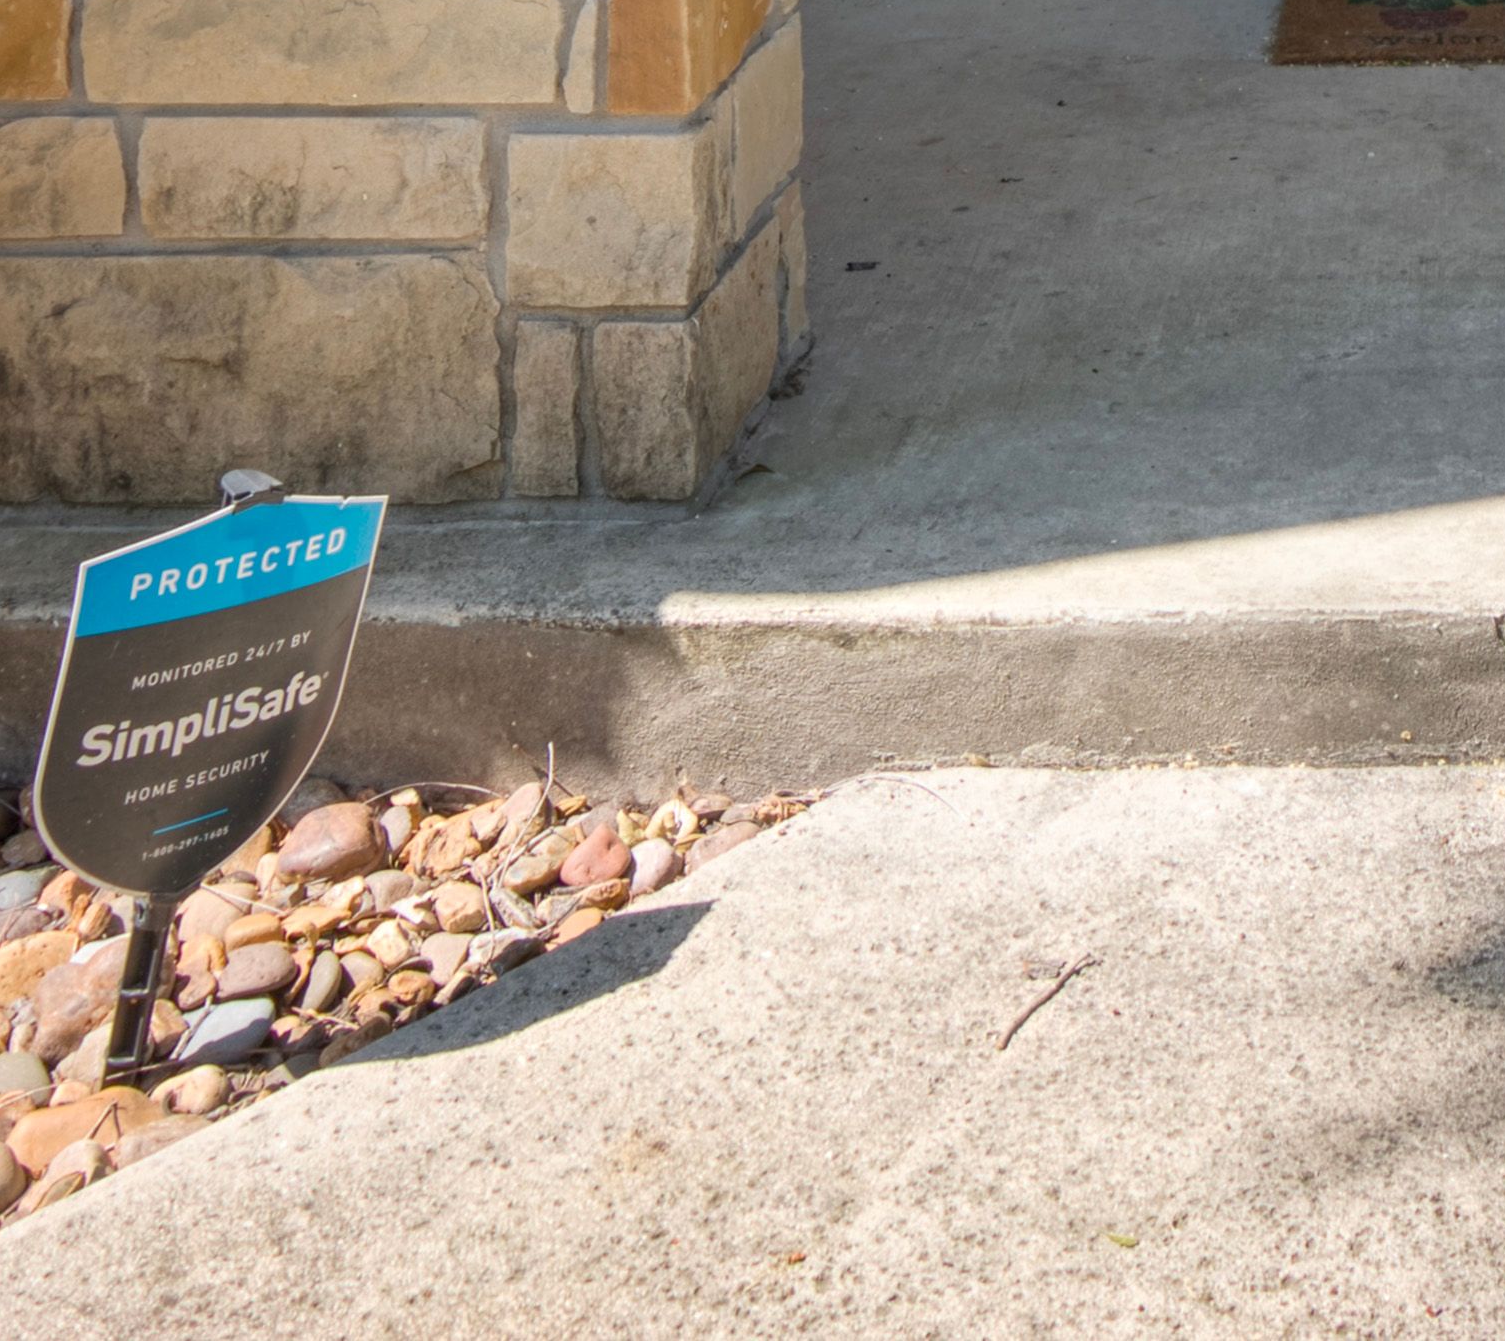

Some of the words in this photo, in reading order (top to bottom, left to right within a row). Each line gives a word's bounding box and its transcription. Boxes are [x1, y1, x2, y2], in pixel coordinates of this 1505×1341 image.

[130, 527, 347, 601] PROTECTED
[131, 652, 239, 690] MONITORED
[244, 639, 286, 662] 24/7
[290, 630, 312, 649] BY
[76, 670, 322, 767] SimpliSafe
[124, 779, 178, 806] HOME
[184, 750, 270, 789] SECURITY
